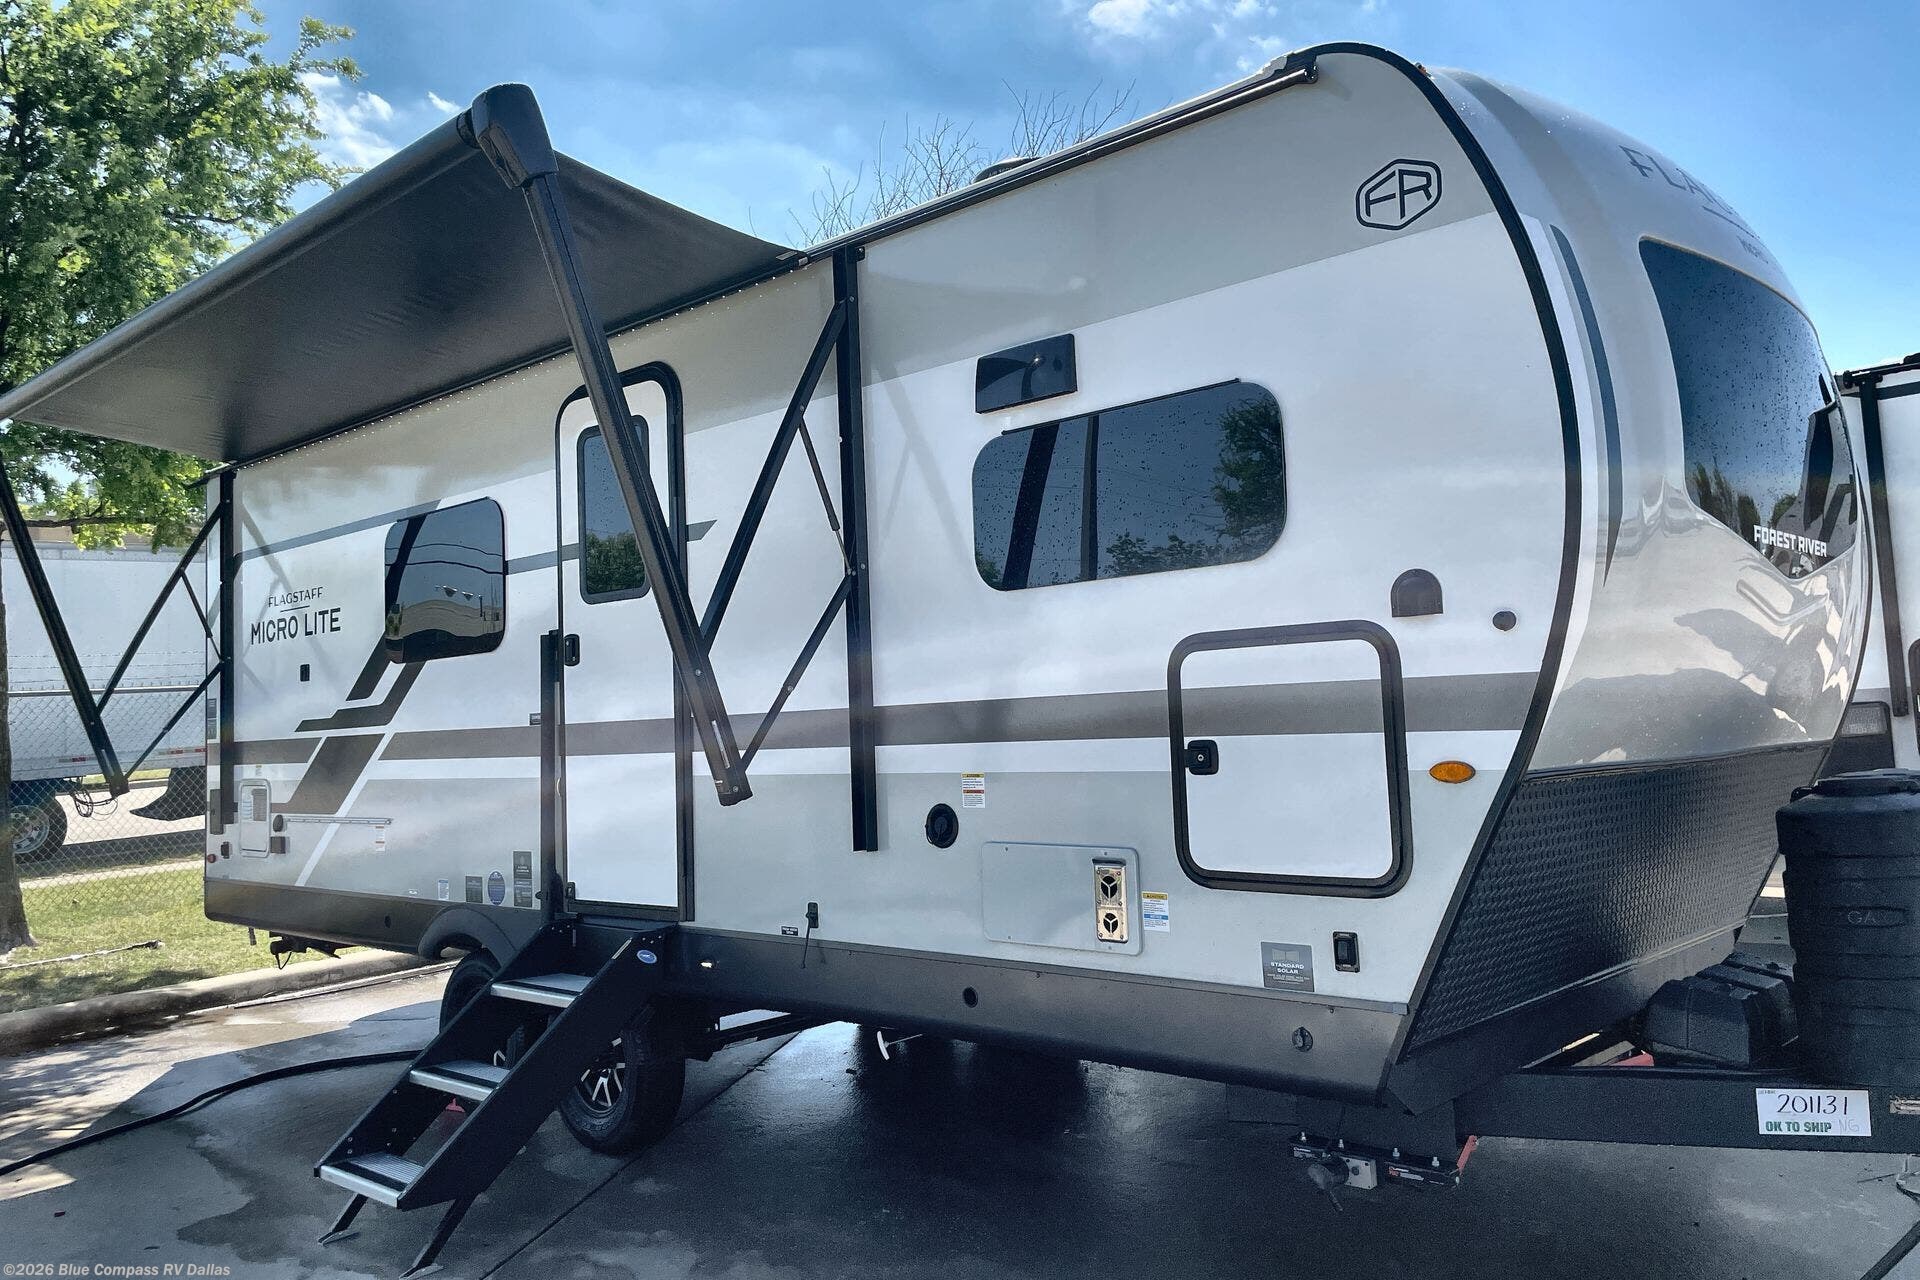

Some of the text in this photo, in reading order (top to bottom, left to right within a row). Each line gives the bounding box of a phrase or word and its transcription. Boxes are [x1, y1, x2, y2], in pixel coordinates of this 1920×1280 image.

[1753, 524, 1827, 558] FOREST RIVER
[268, 586, 324, 608] FLAGSTAFF
[251, 607, 341, 645] MICRO LITE
[1270, 961, 1305, 970] STANDARD
[1776, 1093, 1848, 1115] 201131
[1765, 1120, 1832, 1133] OK TO SHIP
